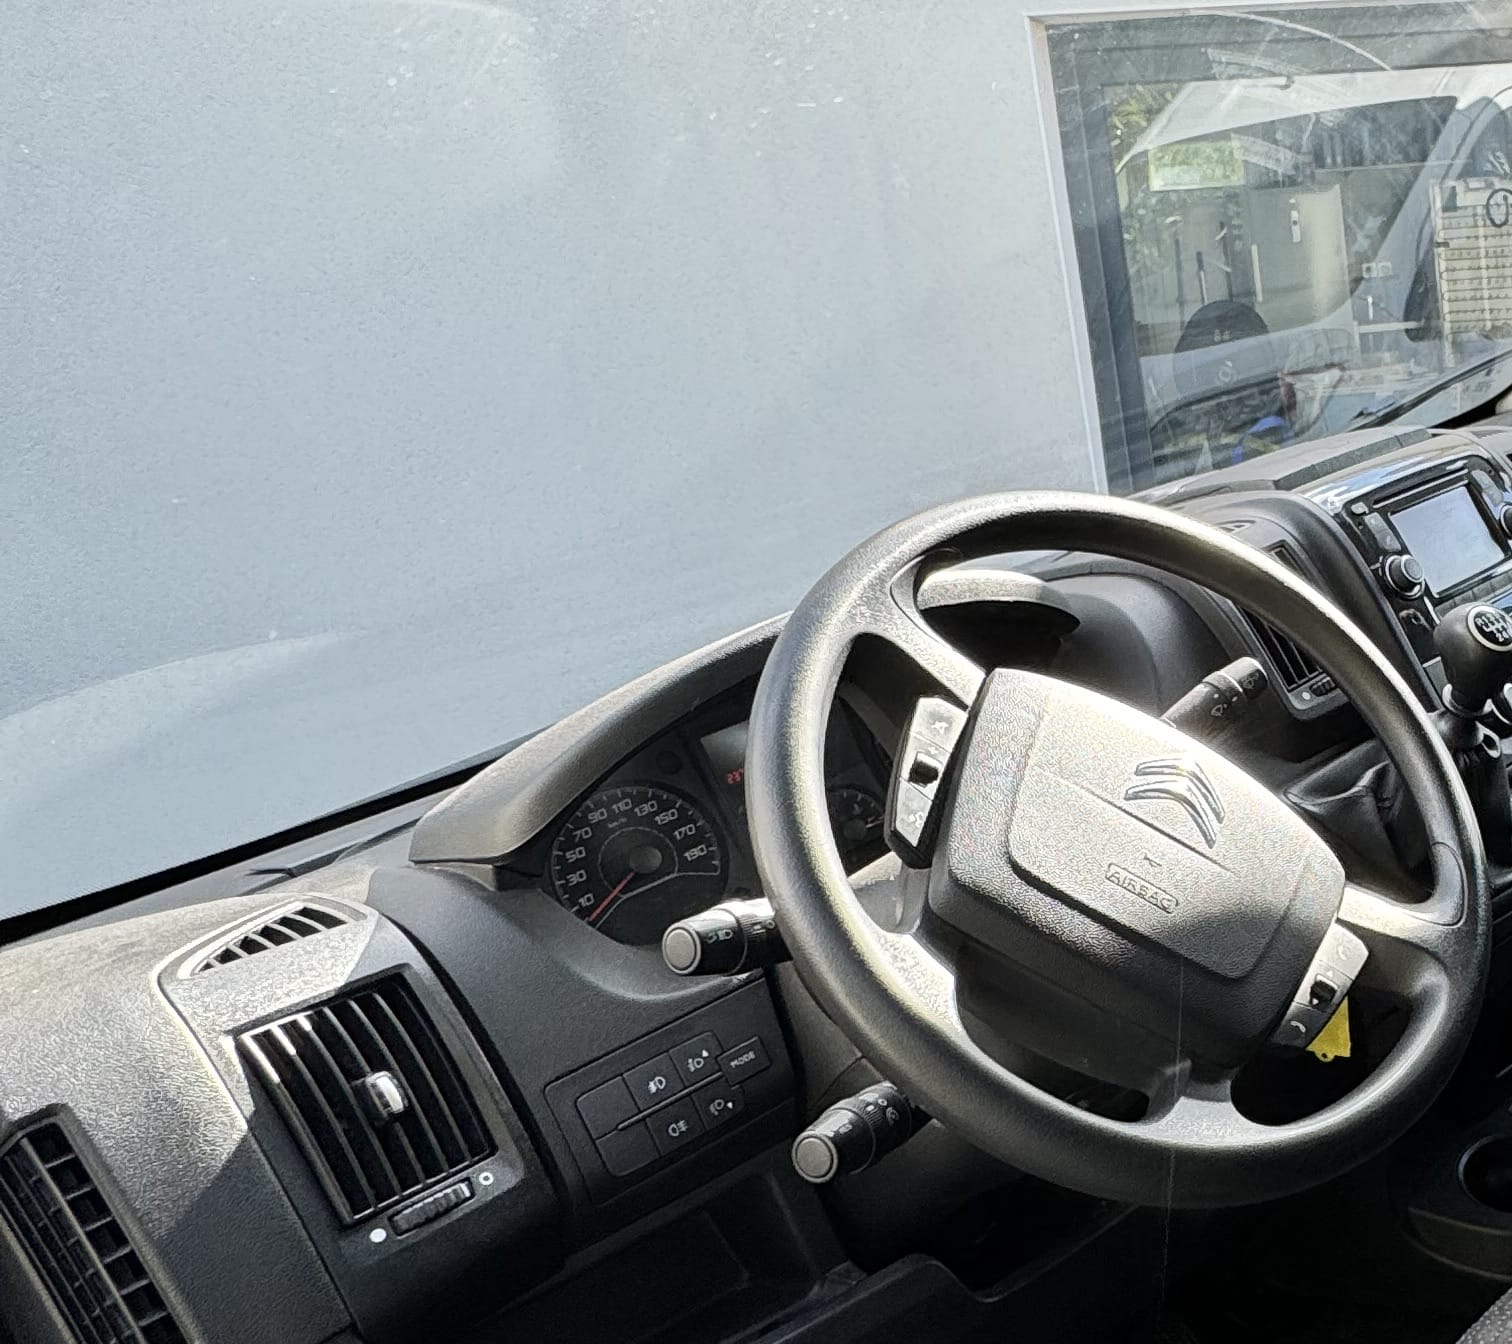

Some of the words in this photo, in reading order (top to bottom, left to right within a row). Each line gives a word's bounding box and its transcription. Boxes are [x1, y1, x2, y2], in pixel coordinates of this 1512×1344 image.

[612, 798, 633, 814] 110
[634, 800, 658, 817] 130
[588, 807, 608, 824] 90
[654, 808, 679, 826] 150
[573, 827, 592, 843] 70
[673, 823, 696, 840] 170
[565, 846, 587, 863] 50
[566, 869, 587, 887] 30
[1107, 870, 1174, 911] AIRBAG
[578, 893, 595, 907] 10
